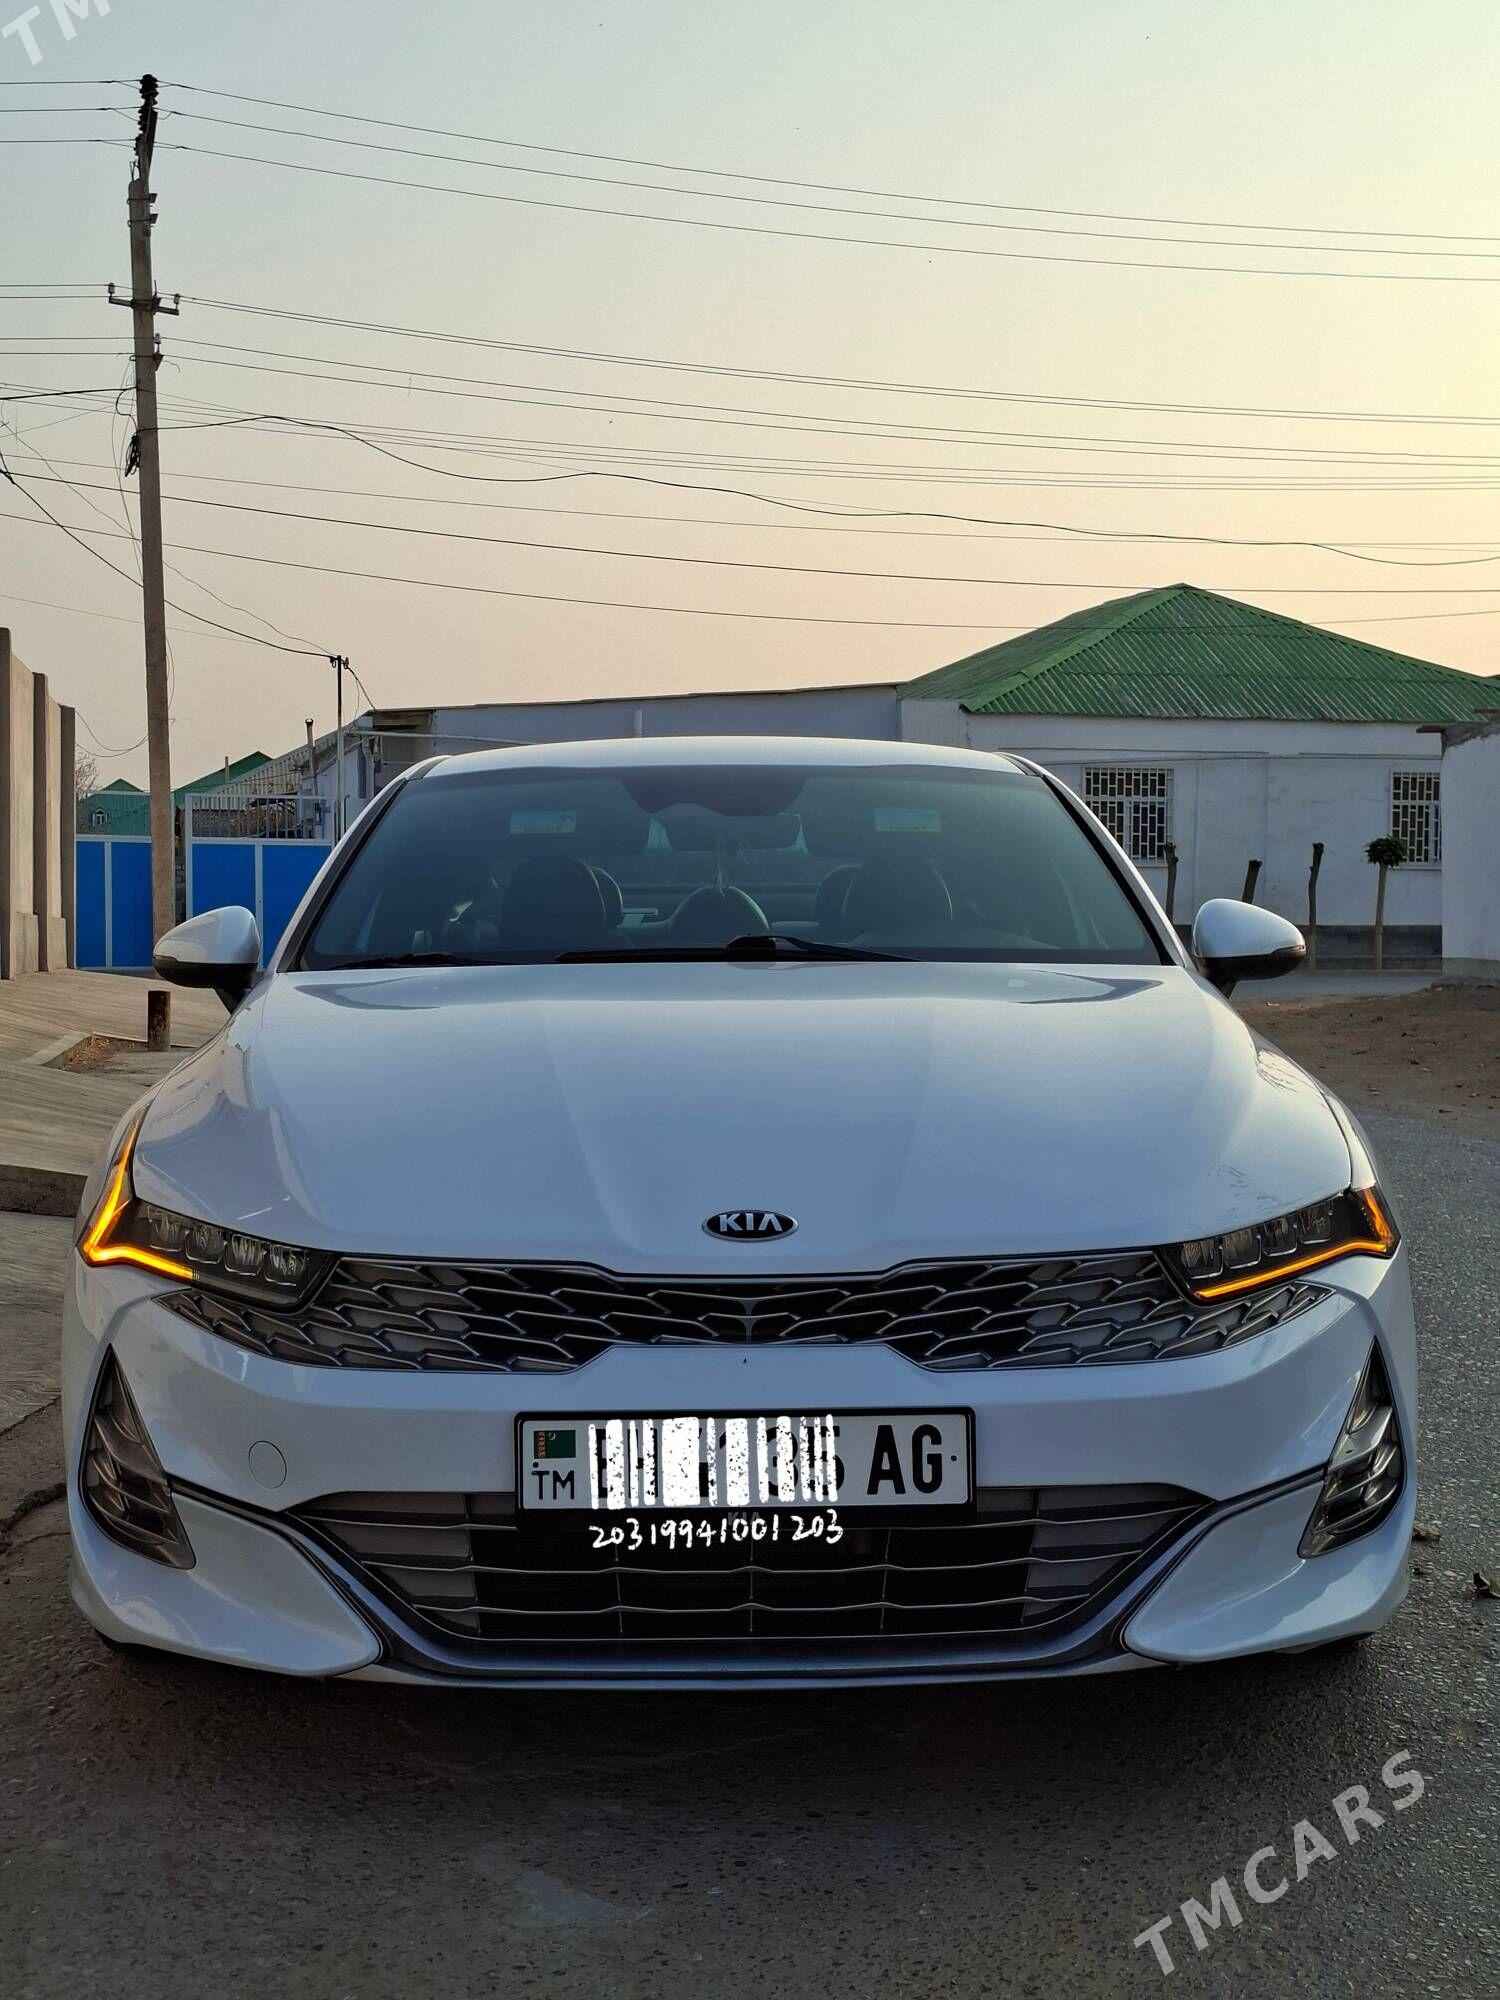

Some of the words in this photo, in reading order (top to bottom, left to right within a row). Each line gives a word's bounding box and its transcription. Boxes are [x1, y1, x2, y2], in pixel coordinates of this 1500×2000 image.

[719, 1213, 782, 1231] KIA
[867, 1424, 943, 1494] AG
[533, 1470, 575, 1499] TM
